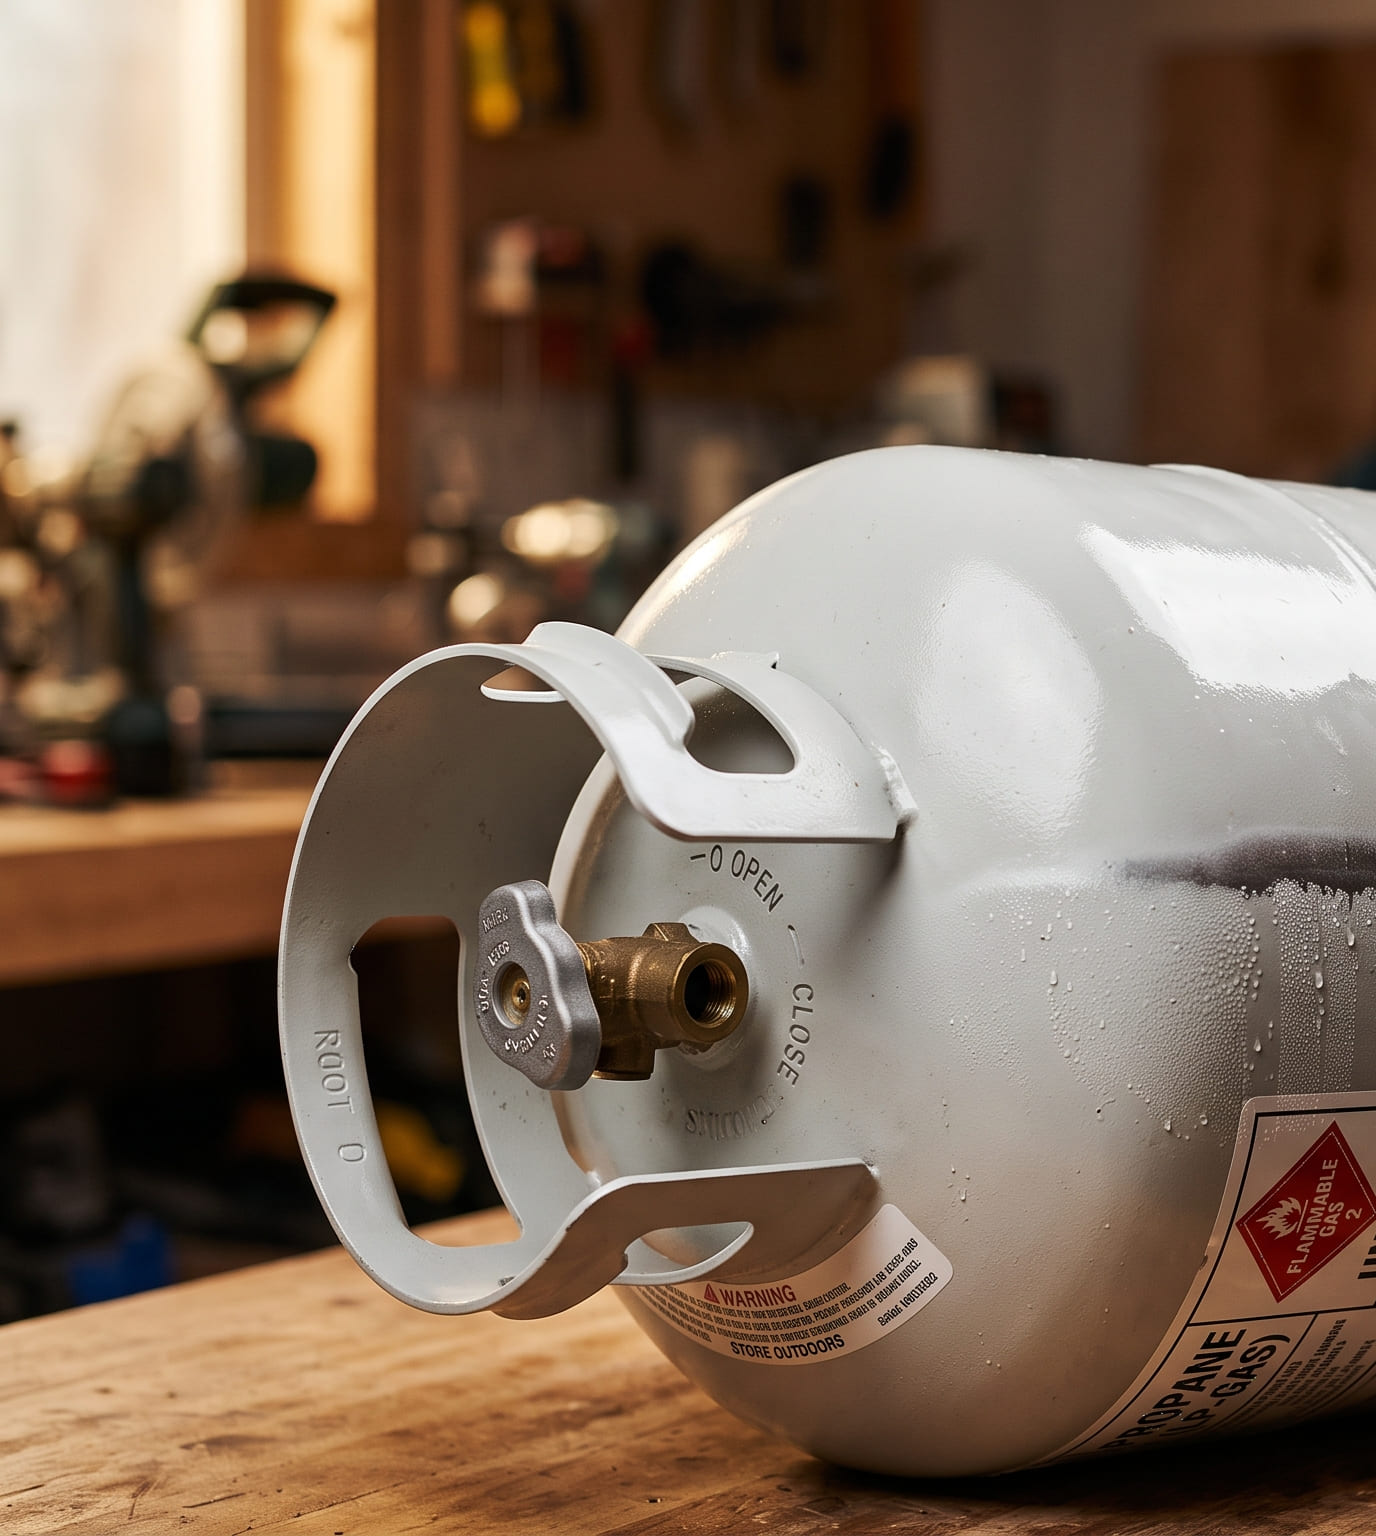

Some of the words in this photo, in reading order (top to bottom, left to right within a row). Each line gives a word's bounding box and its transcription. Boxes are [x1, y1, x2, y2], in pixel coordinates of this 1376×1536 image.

[731, 849, 784, 913] OPEN
[776, 983, 814, 1087] CLOSE
[1286, 1159, 1339, 1275] FLAMMABLE
[1319, 1201, 1345, 1238] GAS
[1346, 1207, 1363, 1220] 2
[719, 1284, 797, 1309] WARNING
[730, 1341, 774, 1360] STORE
[774, 1333, 846, 1360] OUTDOORS
